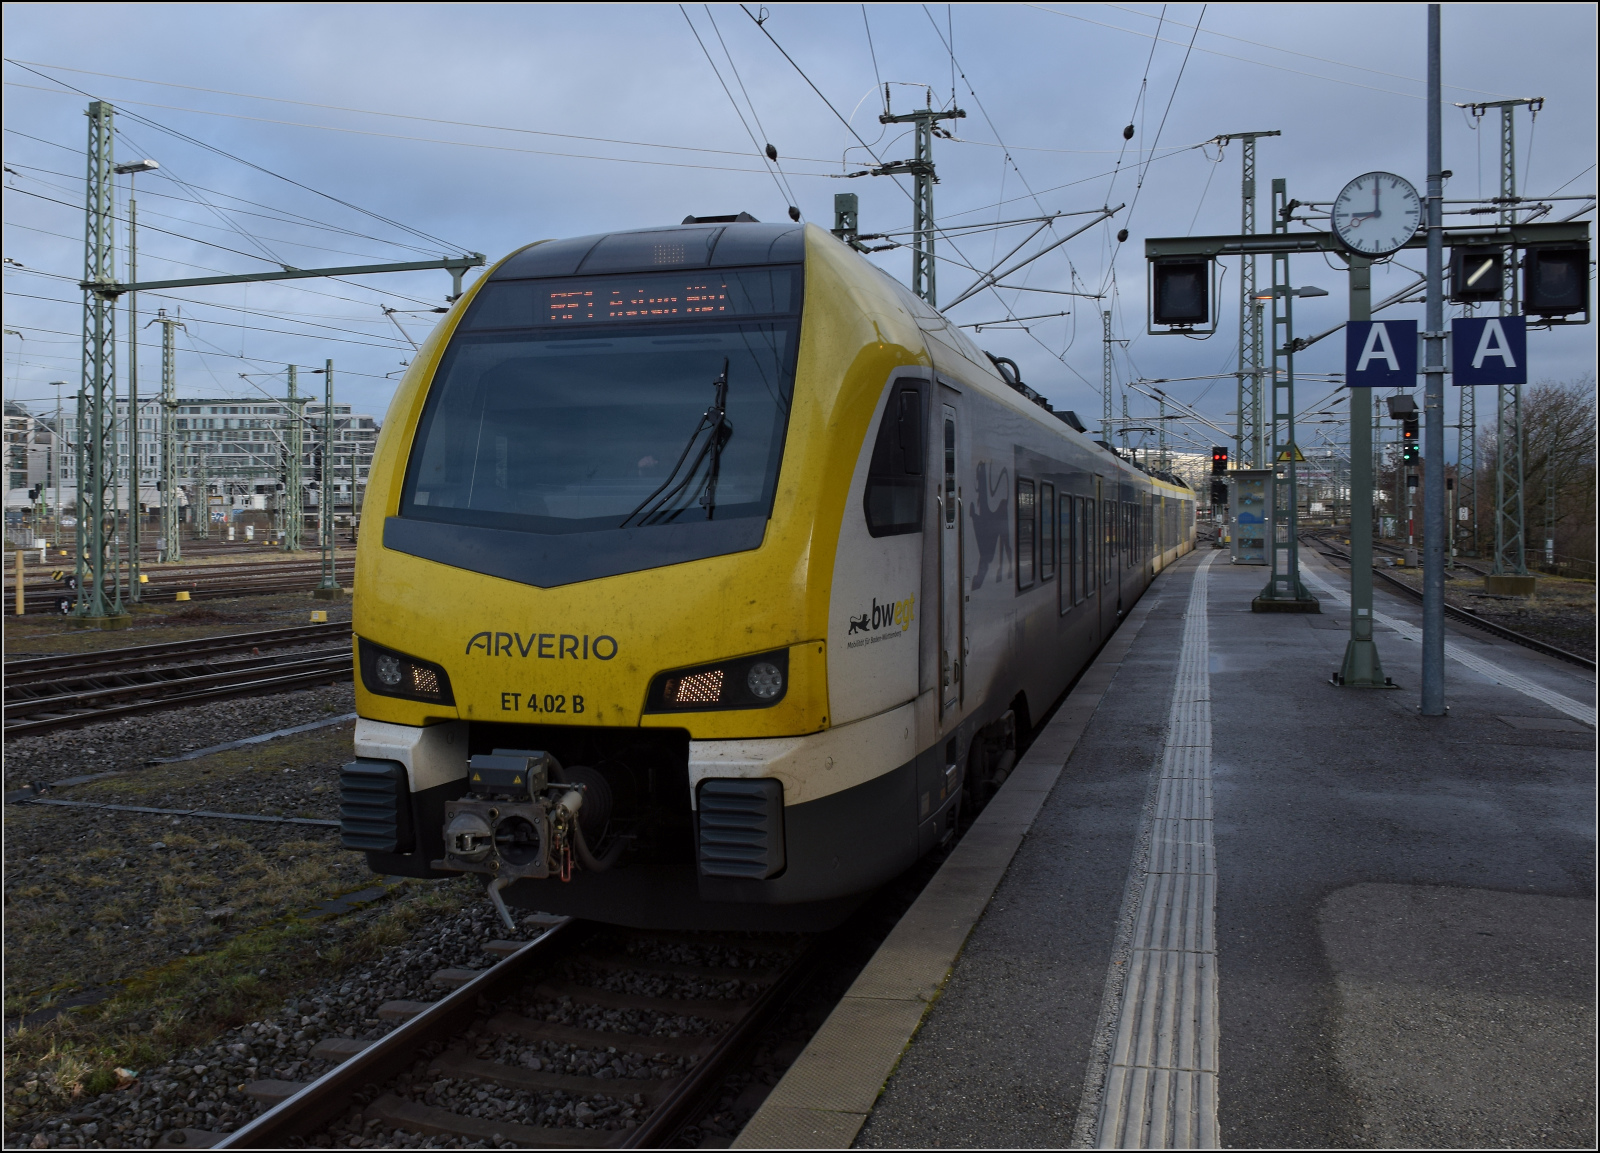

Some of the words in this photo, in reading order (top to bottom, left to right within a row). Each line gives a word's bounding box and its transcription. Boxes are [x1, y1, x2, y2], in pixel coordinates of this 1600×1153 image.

[1355, 322, 1401, 372] A
[1471, 318, 1517, 369] A
[872, 592, 915, 631] bwegt
[465, 631, 619, 661] ARVERIO
[501, 692, 522, 712] ET
[527, 693, 567, 714] 4.02
[572, 695, 585, 714] B
